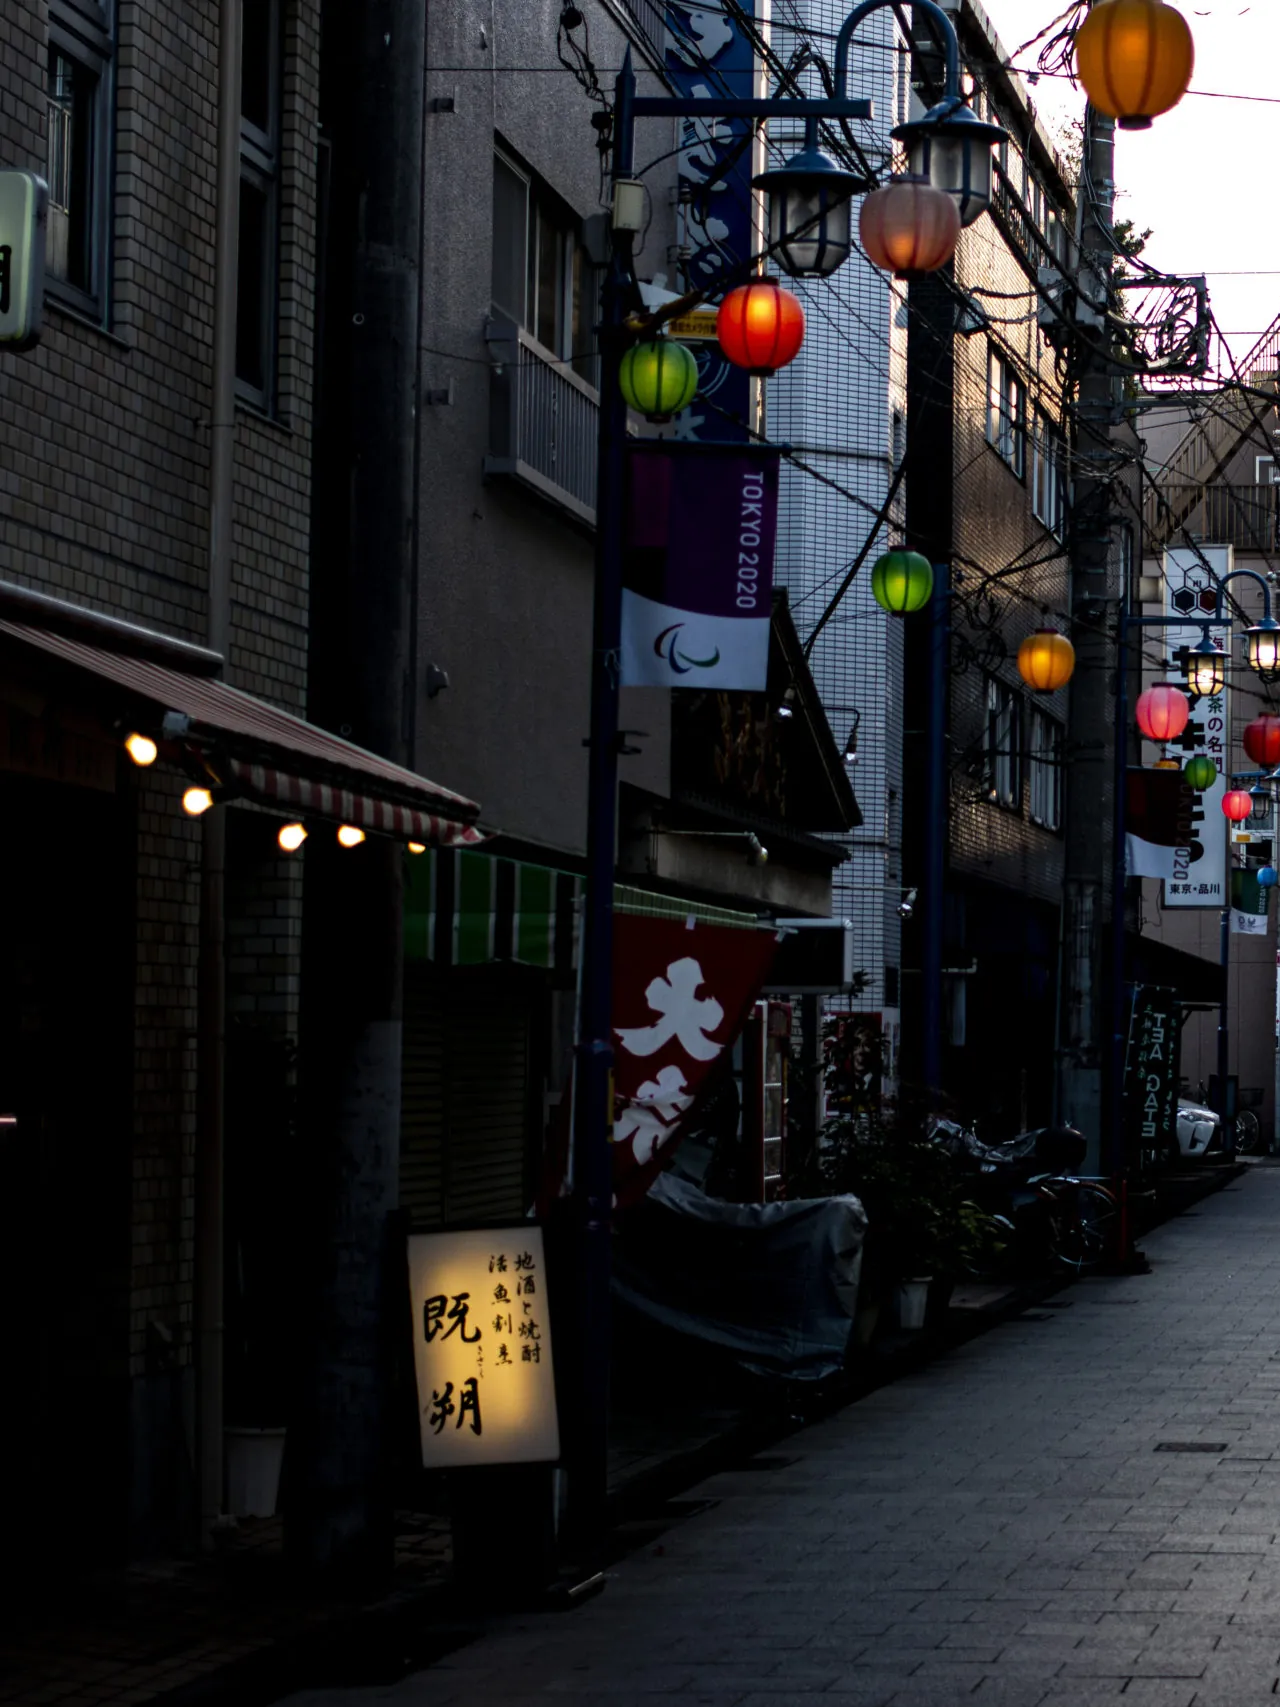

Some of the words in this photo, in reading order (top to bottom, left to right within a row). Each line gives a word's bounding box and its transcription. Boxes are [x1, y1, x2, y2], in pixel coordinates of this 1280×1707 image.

[740, 471, 764, 547] TOKYO
[735, 552, 760, 609] 2020
[514, 1251, 541, 1363] 地酒と焼酎
